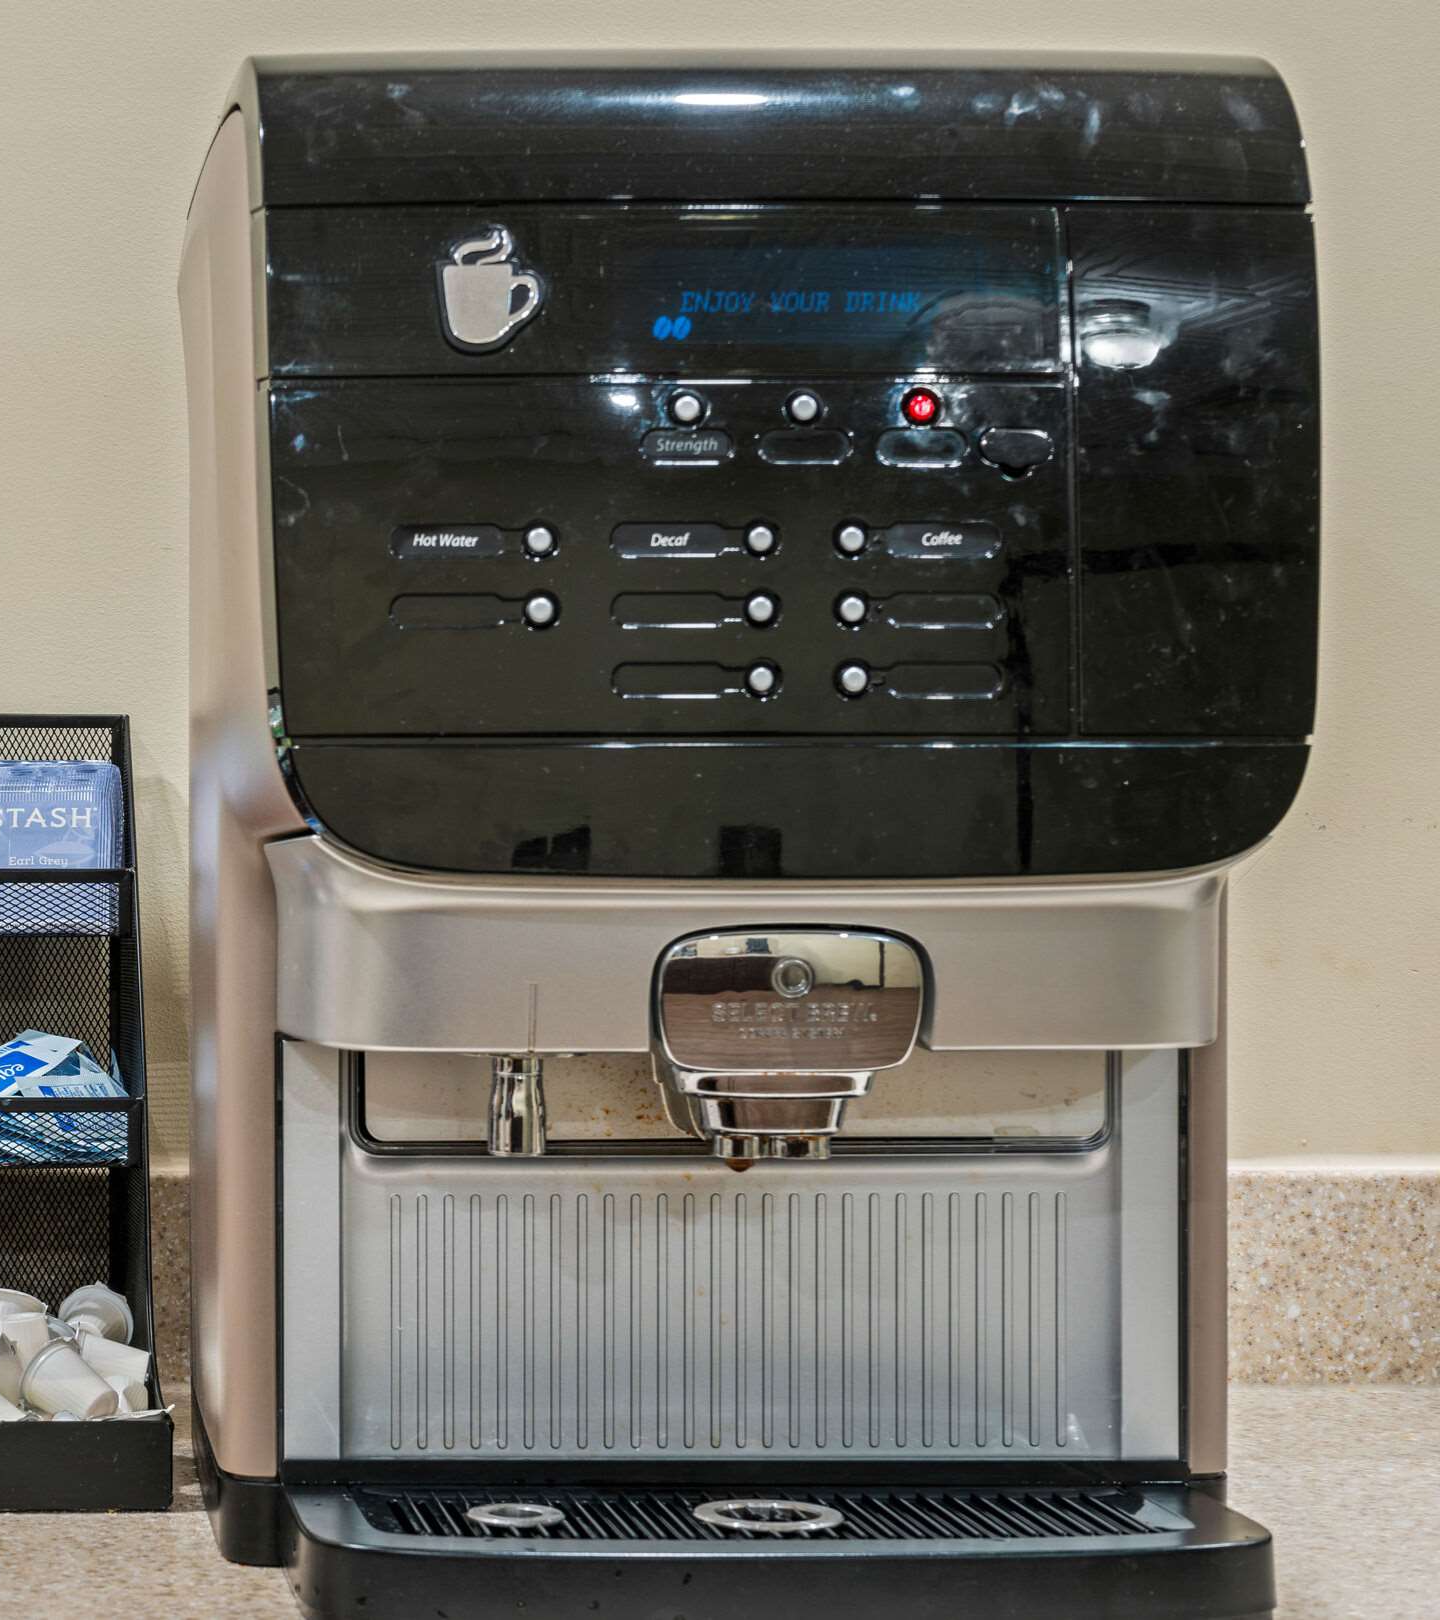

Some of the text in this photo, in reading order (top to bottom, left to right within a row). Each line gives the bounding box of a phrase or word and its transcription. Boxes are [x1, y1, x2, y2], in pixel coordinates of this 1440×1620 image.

[679, 290, 921, 313] ENJOY YOUR DRINK
[656, 437, 719, 456] Strength
[412, 533, 480, 547] Hot Water
[650, 532, 691, 547] Decaf
[921, 531, 964, 546] Coffee
[8, 856, 68, 869] Earl Grey
[711, 1002, 800, 1022] SELECT
